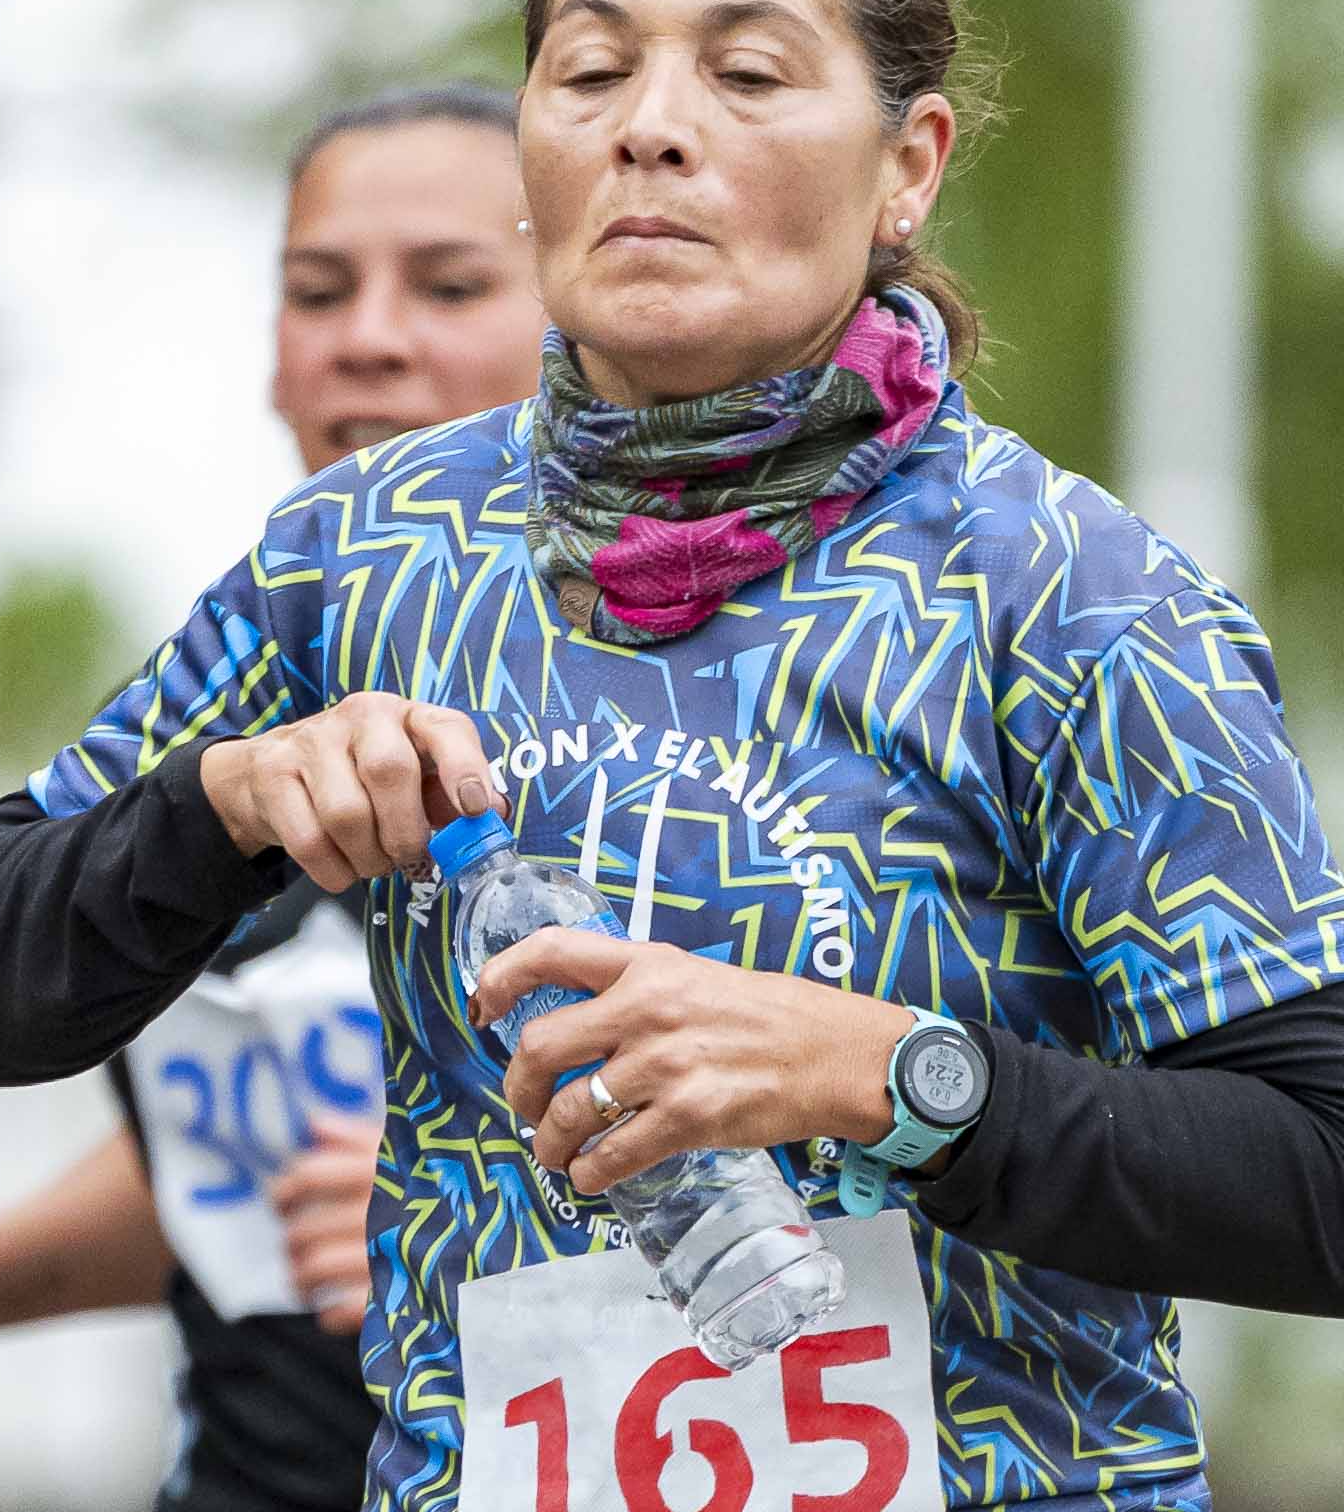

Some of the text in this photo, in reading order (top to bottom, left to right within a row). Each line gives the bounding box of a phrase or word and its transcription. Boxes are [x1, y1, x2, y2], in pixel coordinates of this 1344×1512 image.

[606, 722, 646, 762] X
[653, 729, 706, 781] EL
[708, 760, 855, 979] AUTISMO
